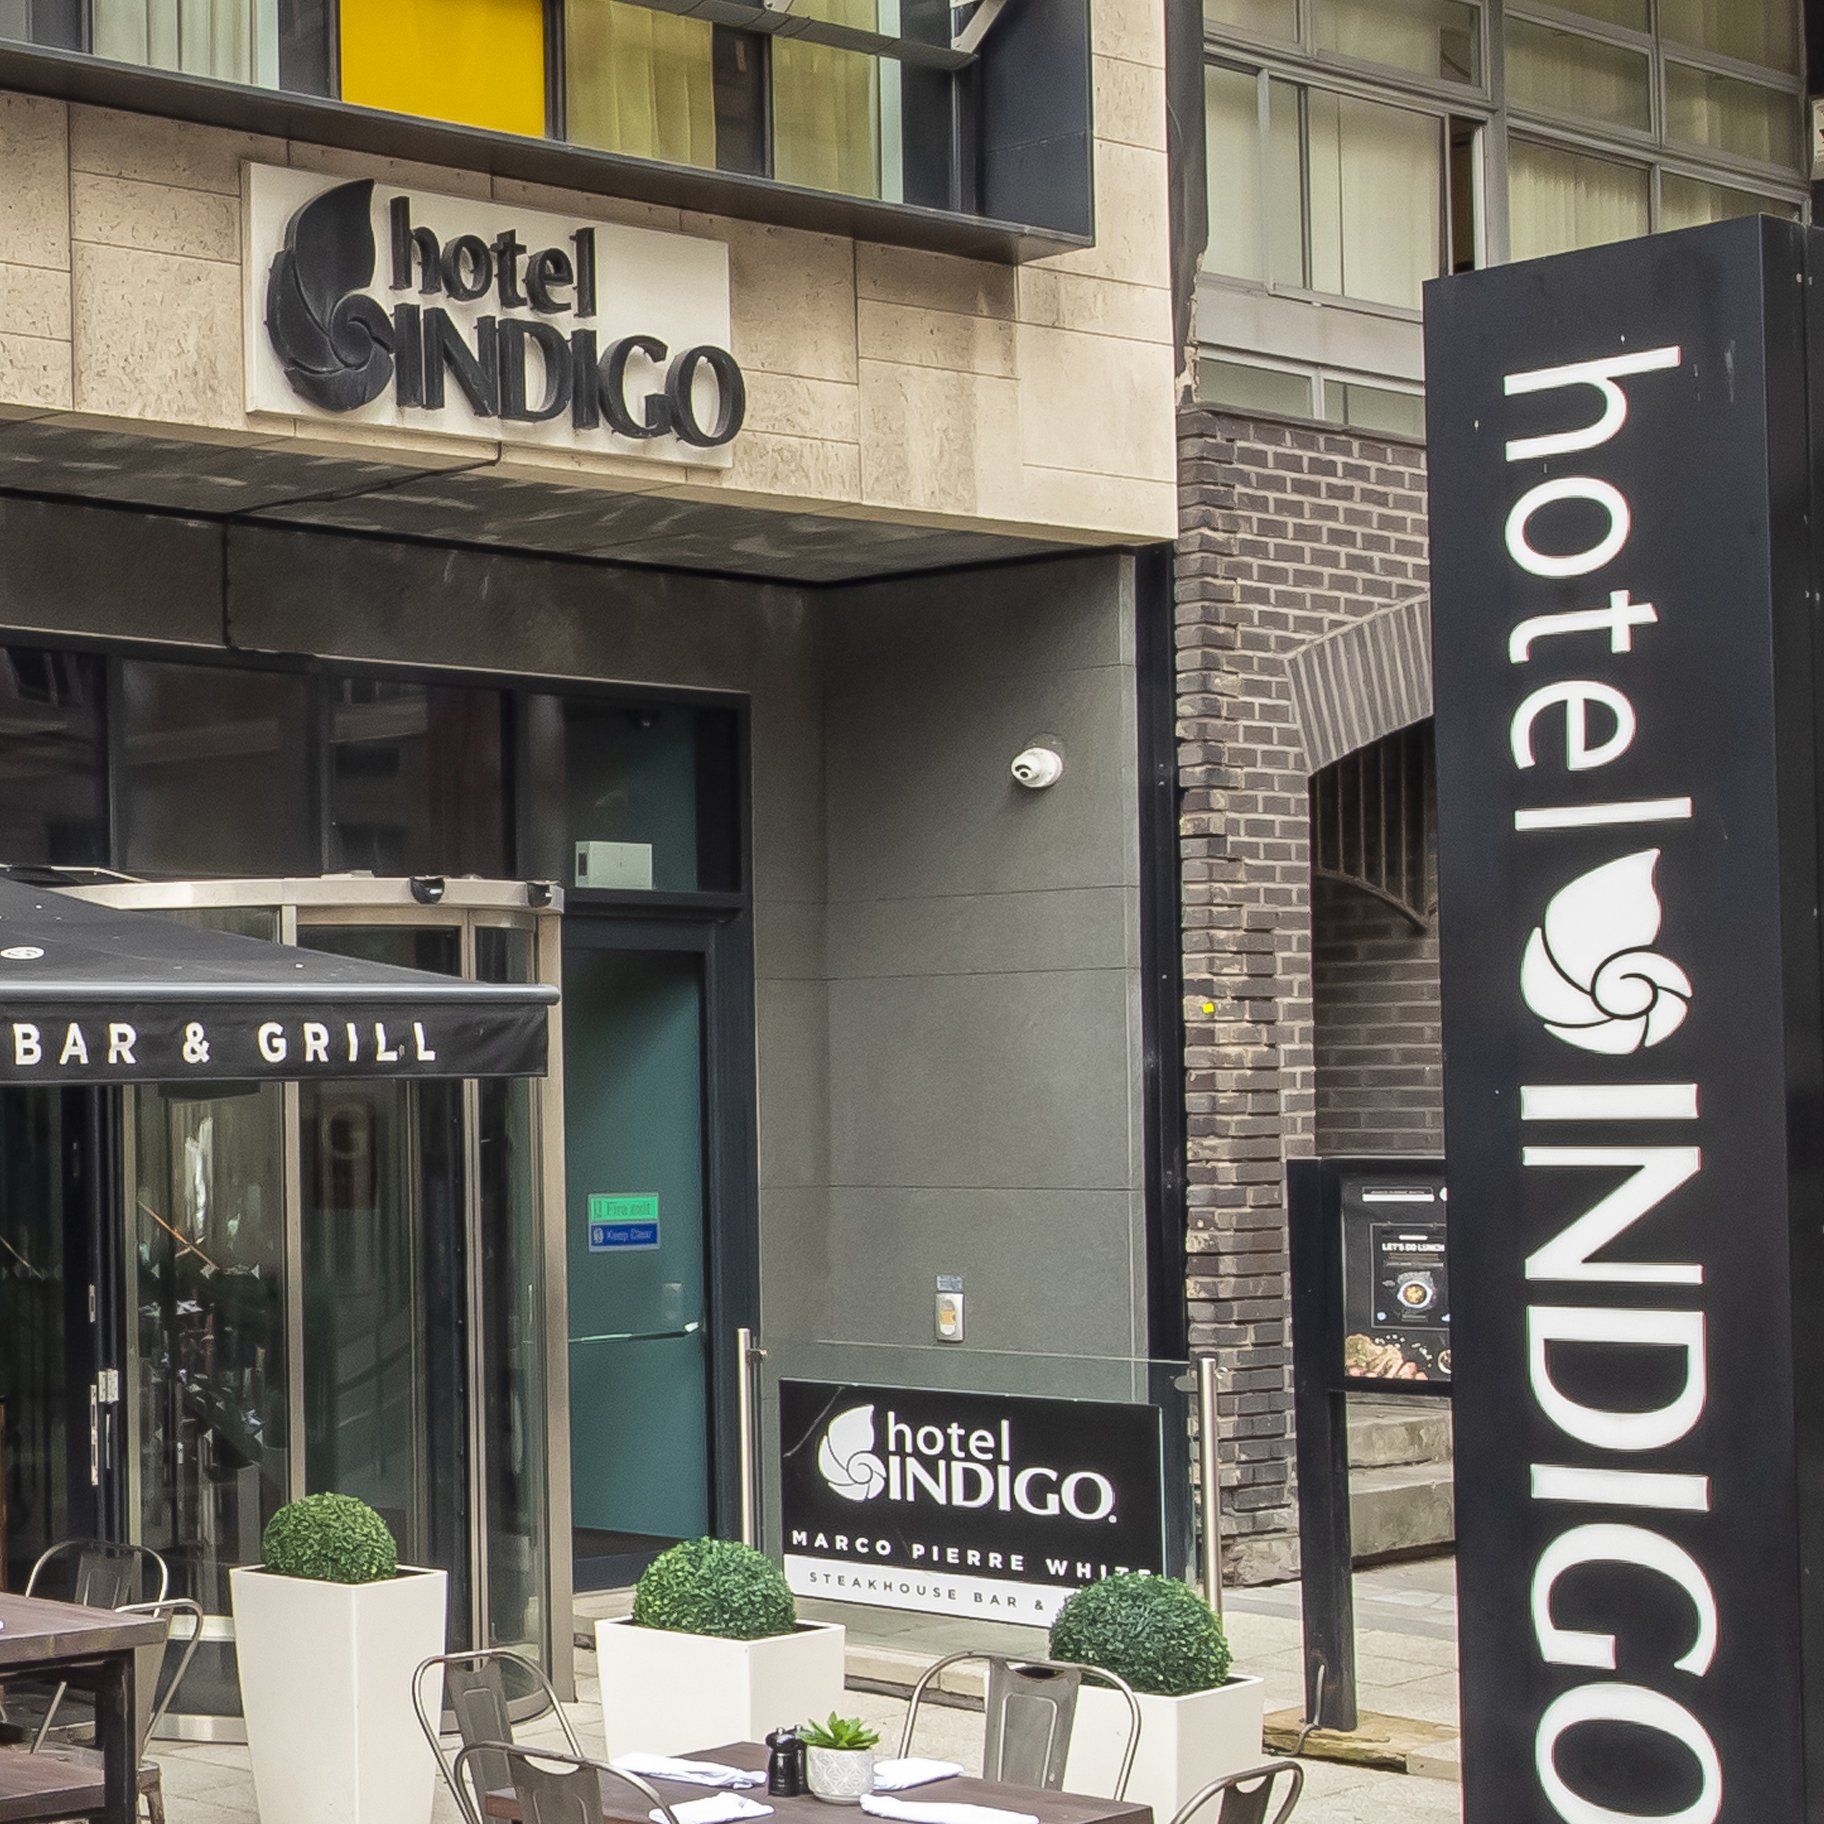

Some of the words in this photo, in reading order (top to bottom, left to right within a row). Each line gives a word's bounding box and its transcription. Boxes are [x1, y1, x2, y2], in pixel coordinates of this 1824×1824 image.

[389, 196, 598, 318] hotel
[393, 303, 746, 448] INDIGO
[1503, 345, 1692, 832] hotel
[13, 1022, 137, 1066] BAR
[182, 1022, 210, 1064] &
[258, 1021, 437, 1063] GRILL
[887, 1410, 1010, 1462] hotel
[792, 1529, 892, 1556] MARCO
[911, 1543, 1024, 1571] PIERRE
[809, 1571, 956, 1600] STEAKHOUSE
[973, 1592, 1017, 1608] BAR
[1034, 1599, 1044, 1611] &
